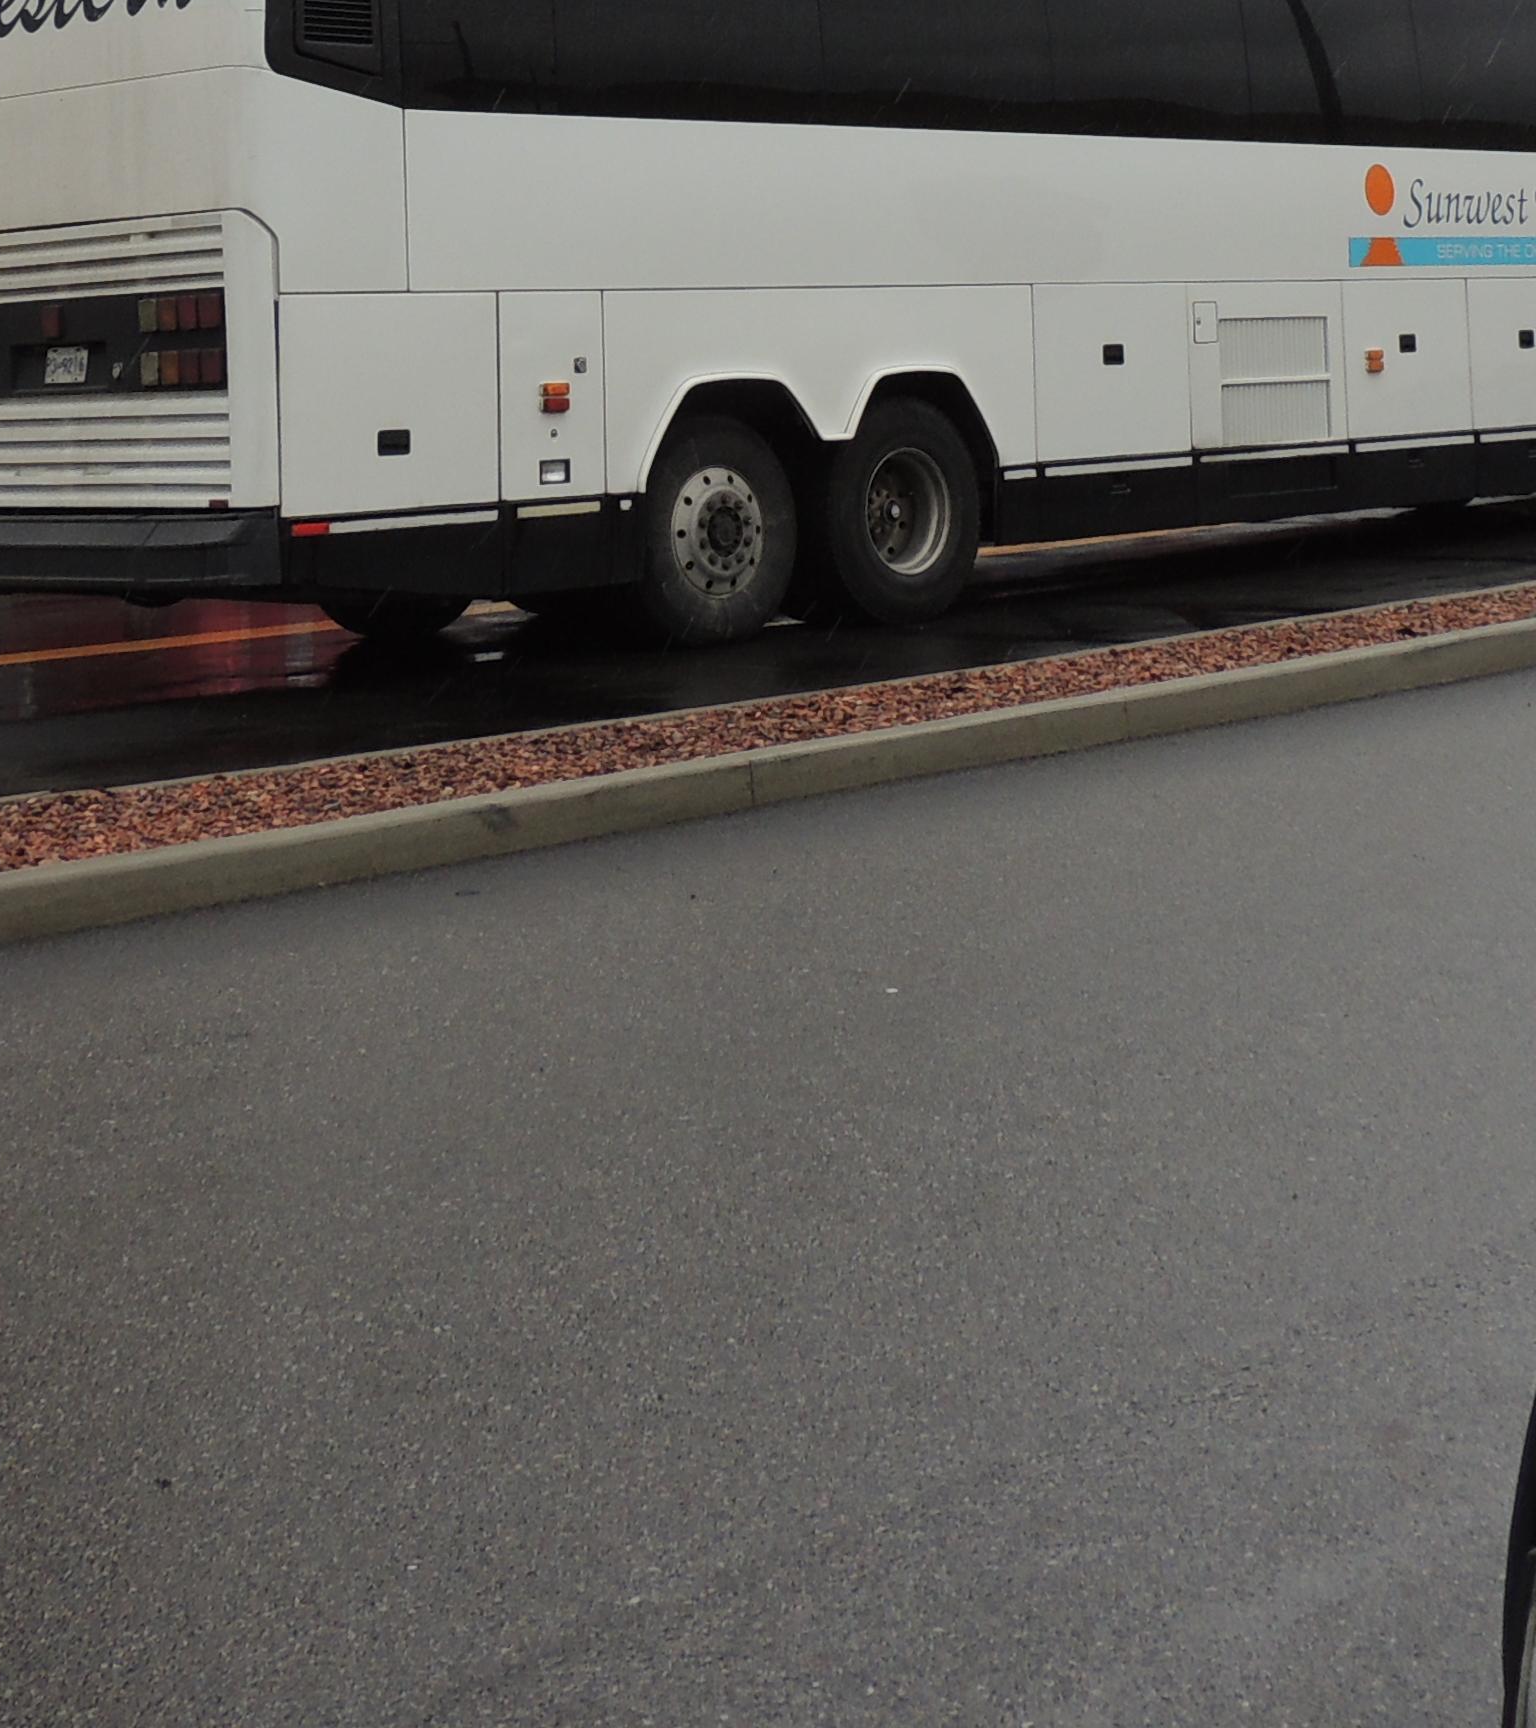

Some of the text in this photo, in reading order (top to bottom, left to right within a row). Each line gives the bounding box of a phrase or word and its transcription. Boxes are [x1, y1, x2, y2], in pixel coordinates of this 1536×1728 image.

[1403, 178, 1528, 228] Sunwest
[1436, 243, 1493, 258] SERVING
[1498, 243, 1520, 257] THE
